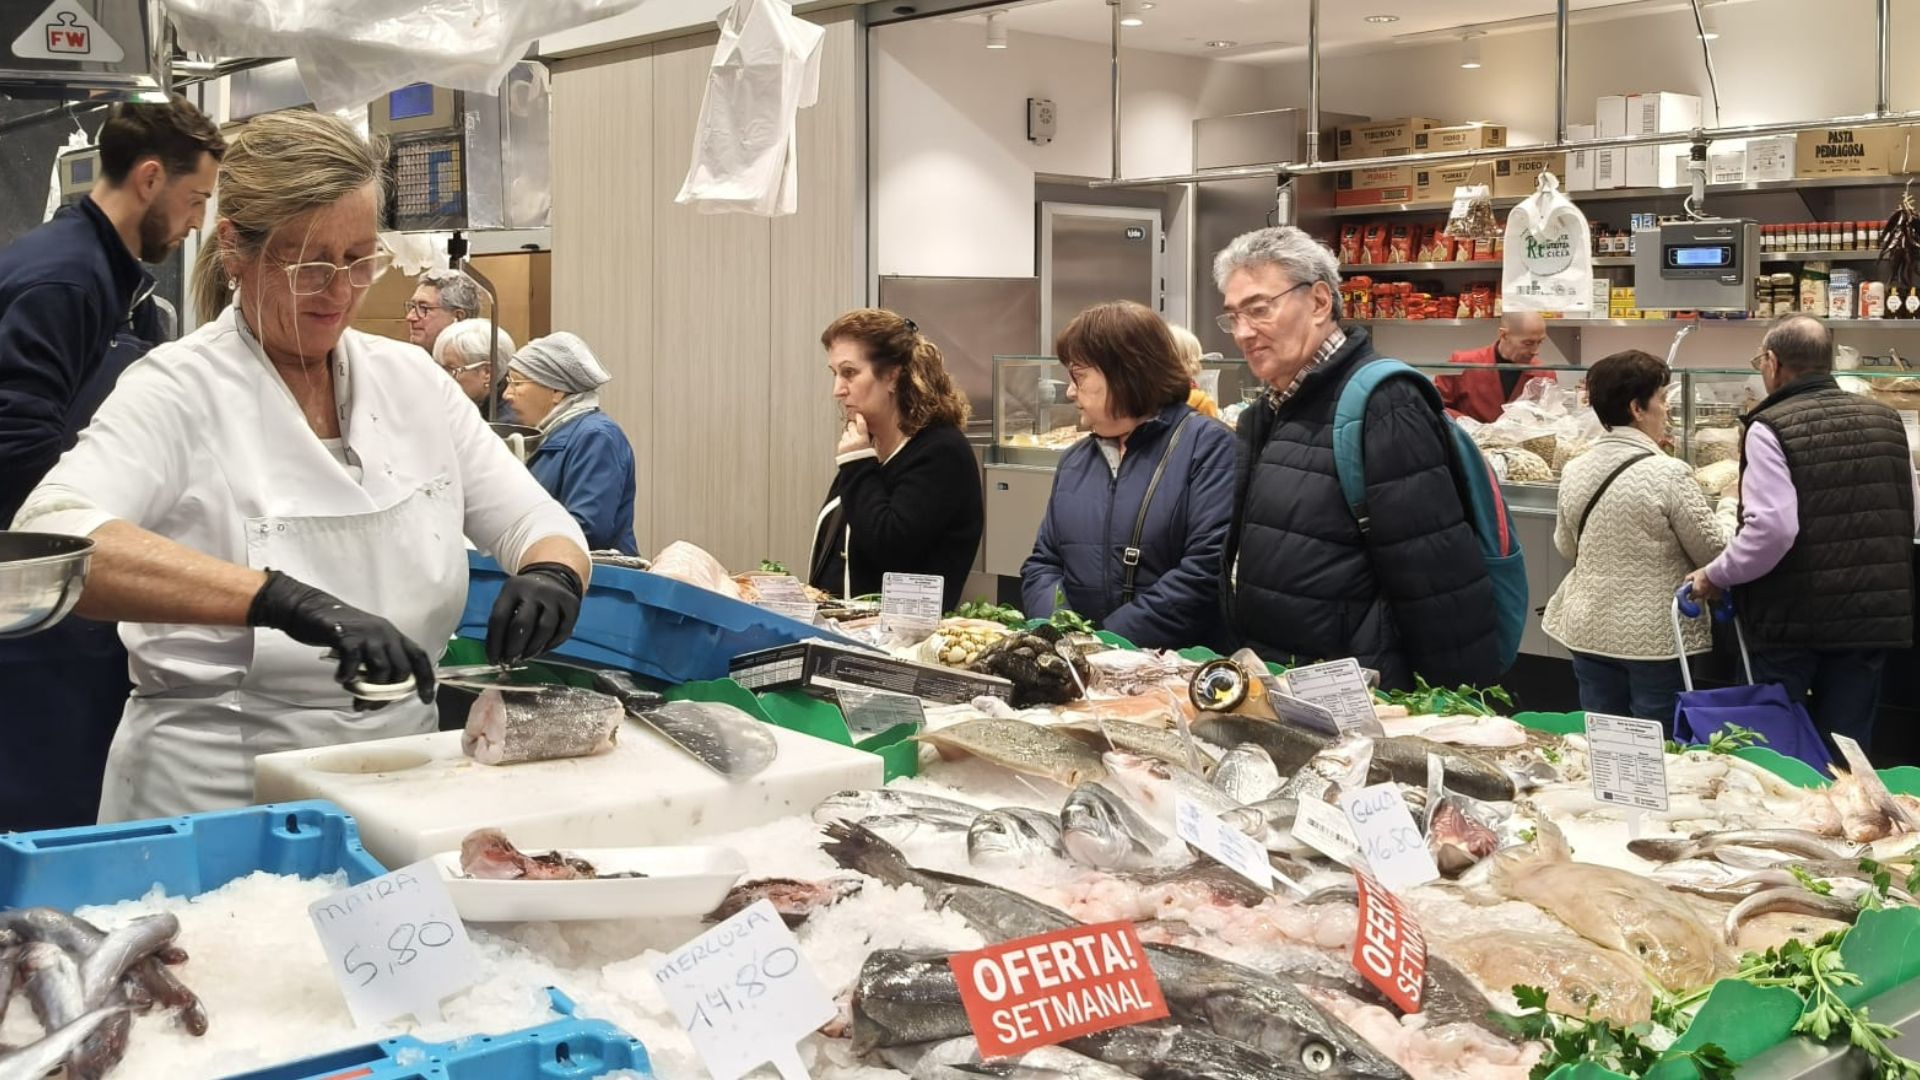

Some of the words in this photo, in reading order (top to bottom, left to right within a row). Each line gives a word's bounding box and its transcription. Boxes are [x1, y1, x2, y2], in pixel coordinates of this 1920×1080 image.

[51, 31, 85, 47] FW
[1815, 144, 1865, 158] PEDRAGOSA
[1828, 130, 1854, 144] PASTA
[1518, 161, 1542, 171] FIDEO
[343, 921, 455, 988] 5,80
[655, 911, 770, 984] MERLUZA
[972, 930, 1139, 1002] OFERTA!
[991, 978, 1154, 1044] SETMANAL
